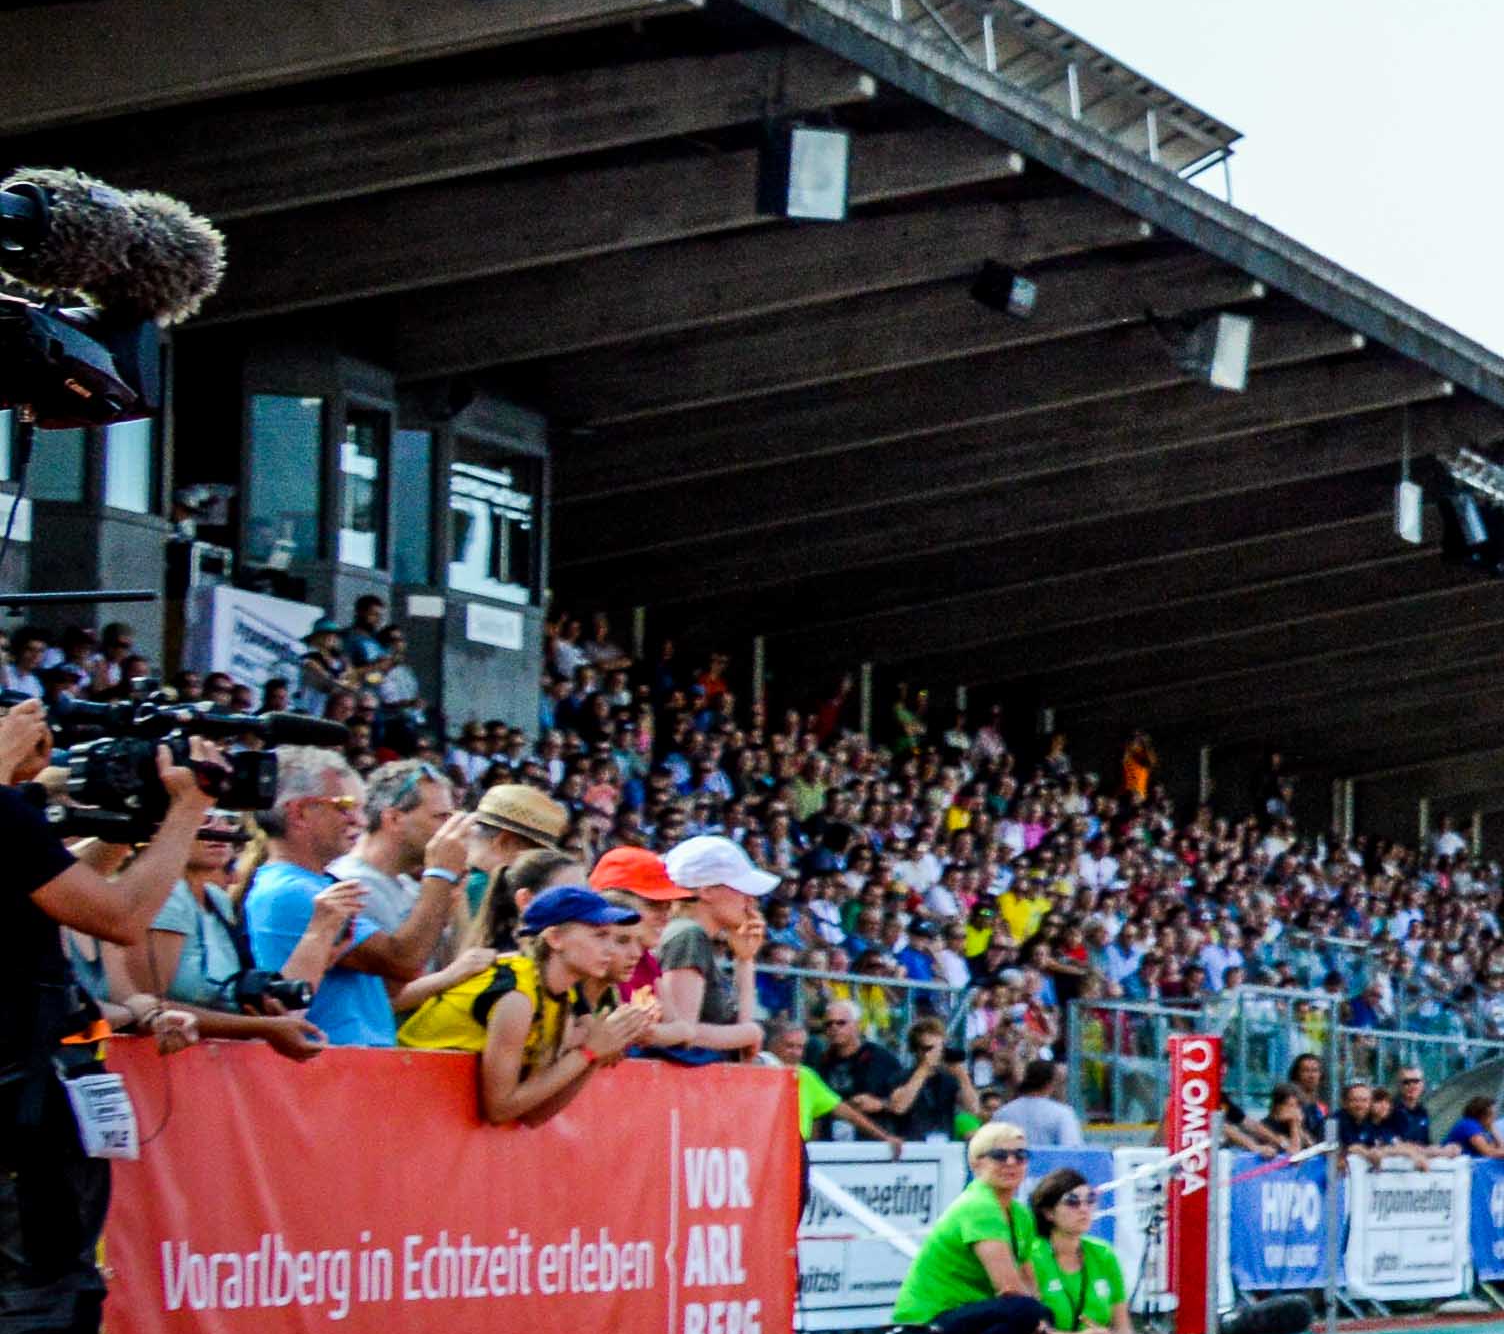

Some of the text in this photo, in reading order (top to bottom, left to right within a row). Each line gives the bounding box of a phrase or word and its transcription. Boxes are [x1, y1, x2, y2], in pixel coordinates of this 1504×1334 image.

[1181, 1077, 1210, 1196] OMEGA
[683, 1146, 753, 1210] VOR
[1261, 1181, 1322, 1233] HYPO
[160, 1225, 656, 1321] Vorarlberg in Echtzeit erleben
[683, 1223, 747, 1288] ARL
